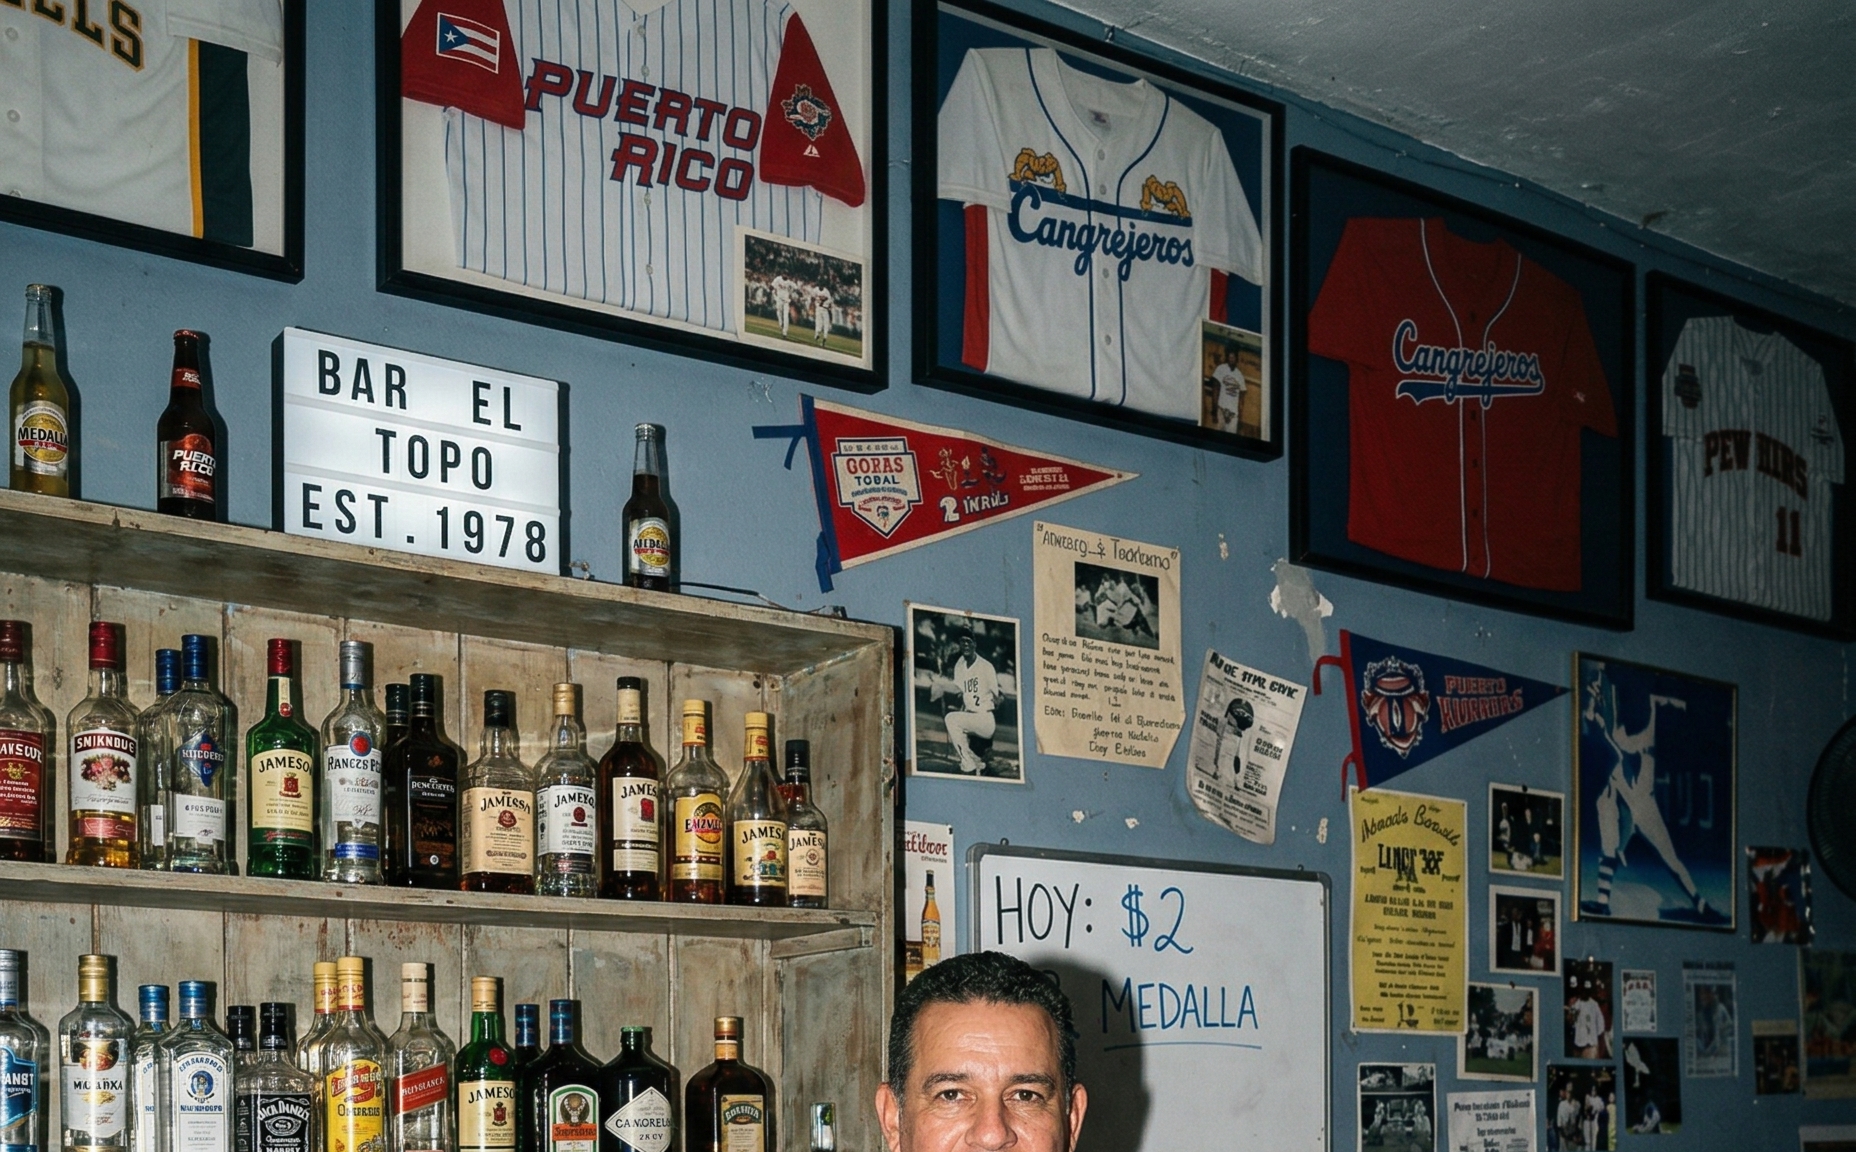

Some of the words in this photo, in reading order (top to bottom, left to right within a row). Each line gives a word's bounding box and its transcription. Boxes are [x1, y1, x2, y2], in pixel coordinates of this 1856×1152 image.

[525, 57, 762, 152] PUERTO
[610, 132, 754, 202] RICO
[1007, 184, 1194, 282] Cangrejeros
[317, 348, 408, 411] BAR
[472, 379, 522, 432] EL
[1393, 318, 1545, 410] Cangrejeros
[375, 427, 493, 491] TOPO
[996, 875, 1093, 949] HOY:
[1121, 883, 1194, 955] $2
[1102, 977, 1259, 1034] MEDALLA
